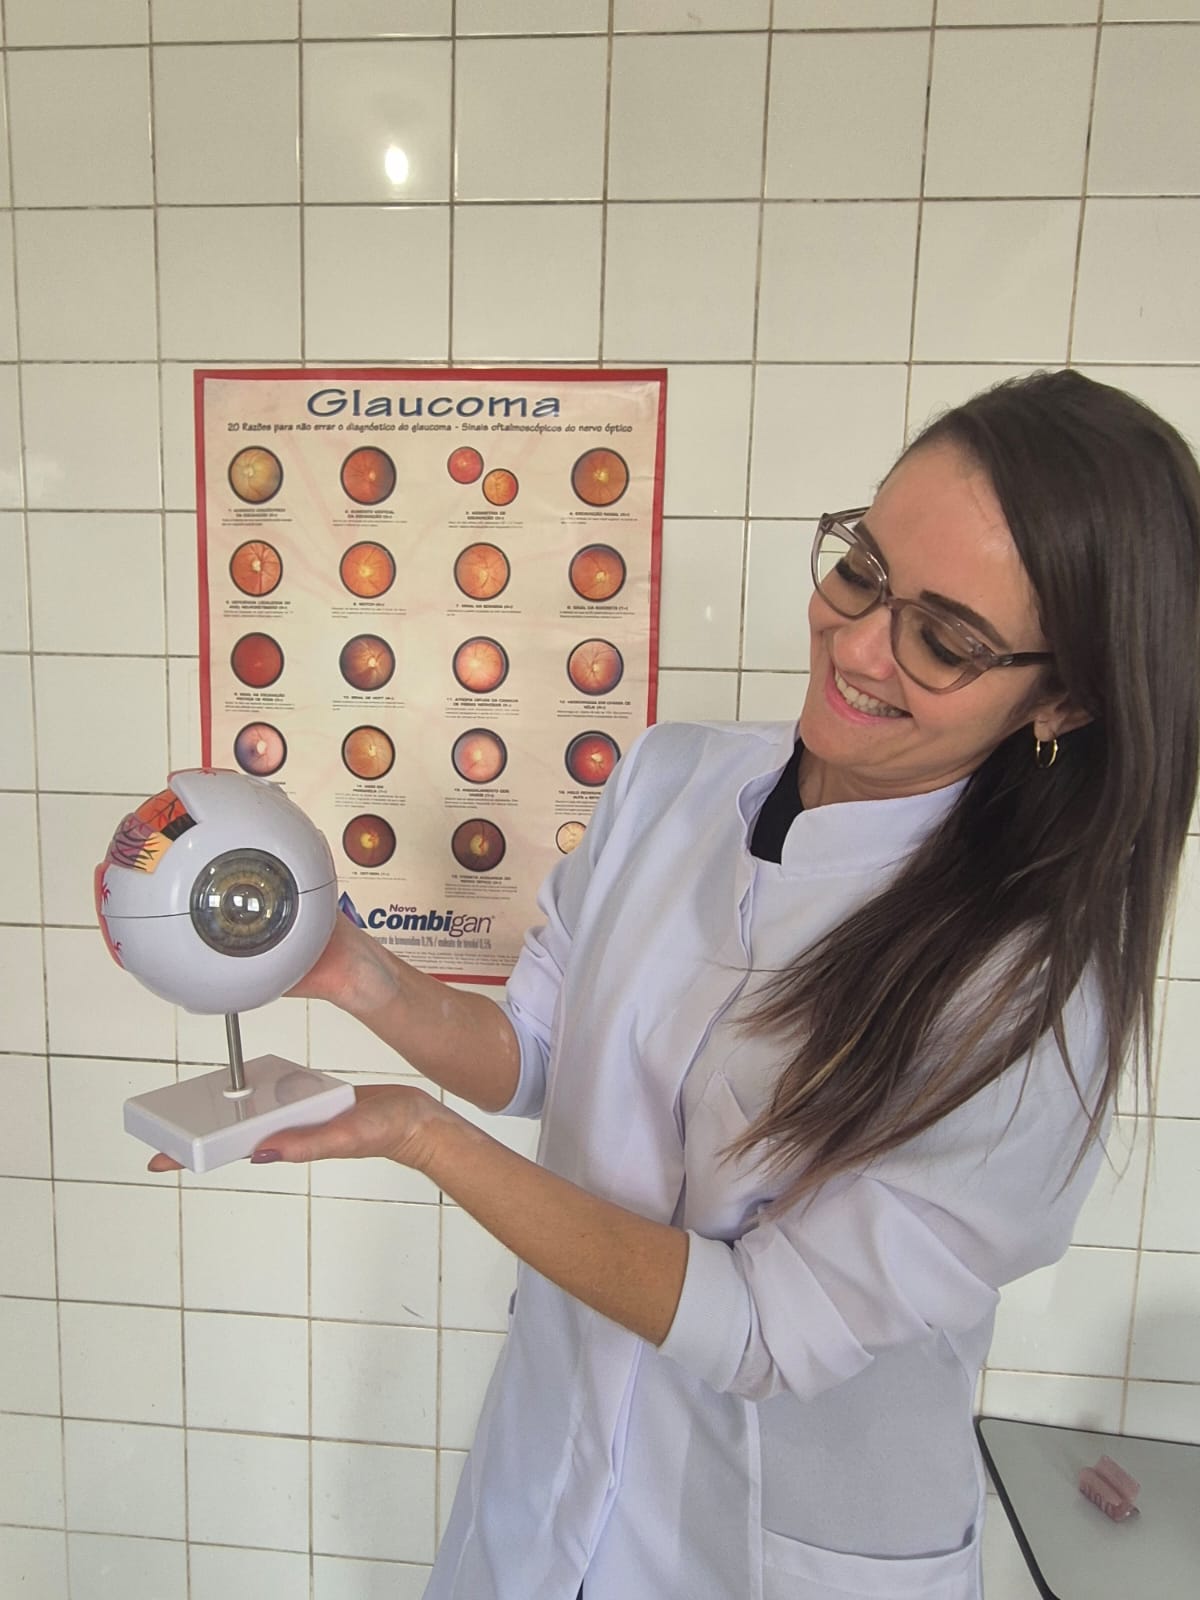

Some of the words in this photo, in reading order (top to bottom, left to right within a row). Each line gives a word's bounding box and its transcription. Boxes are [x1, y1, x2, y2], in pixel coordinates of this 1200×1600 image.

[307, 388, 561, 418] Glaucoma
[227, 423, 240, 432] 20
[242, 422, 272, 432] Razões
[274, 425, 294, 433] para
[296, 423, 312, 432] não
[346, 423, 396, 433] diagnóstico
[398, 423, 409, 432] do
[411, 423, 452, 433] glaucoma
[461, 423, 489, 432] Sinais
[491, 422, 562, 435] oftalmoscópicos
[565, 424, 576, 433] do
[578, 425, 603, 433] nervo
[604, 423, 633, 435] óptico
[389, 904, 417, 913] Novo
[367, 908, 492, 937] Combigan
